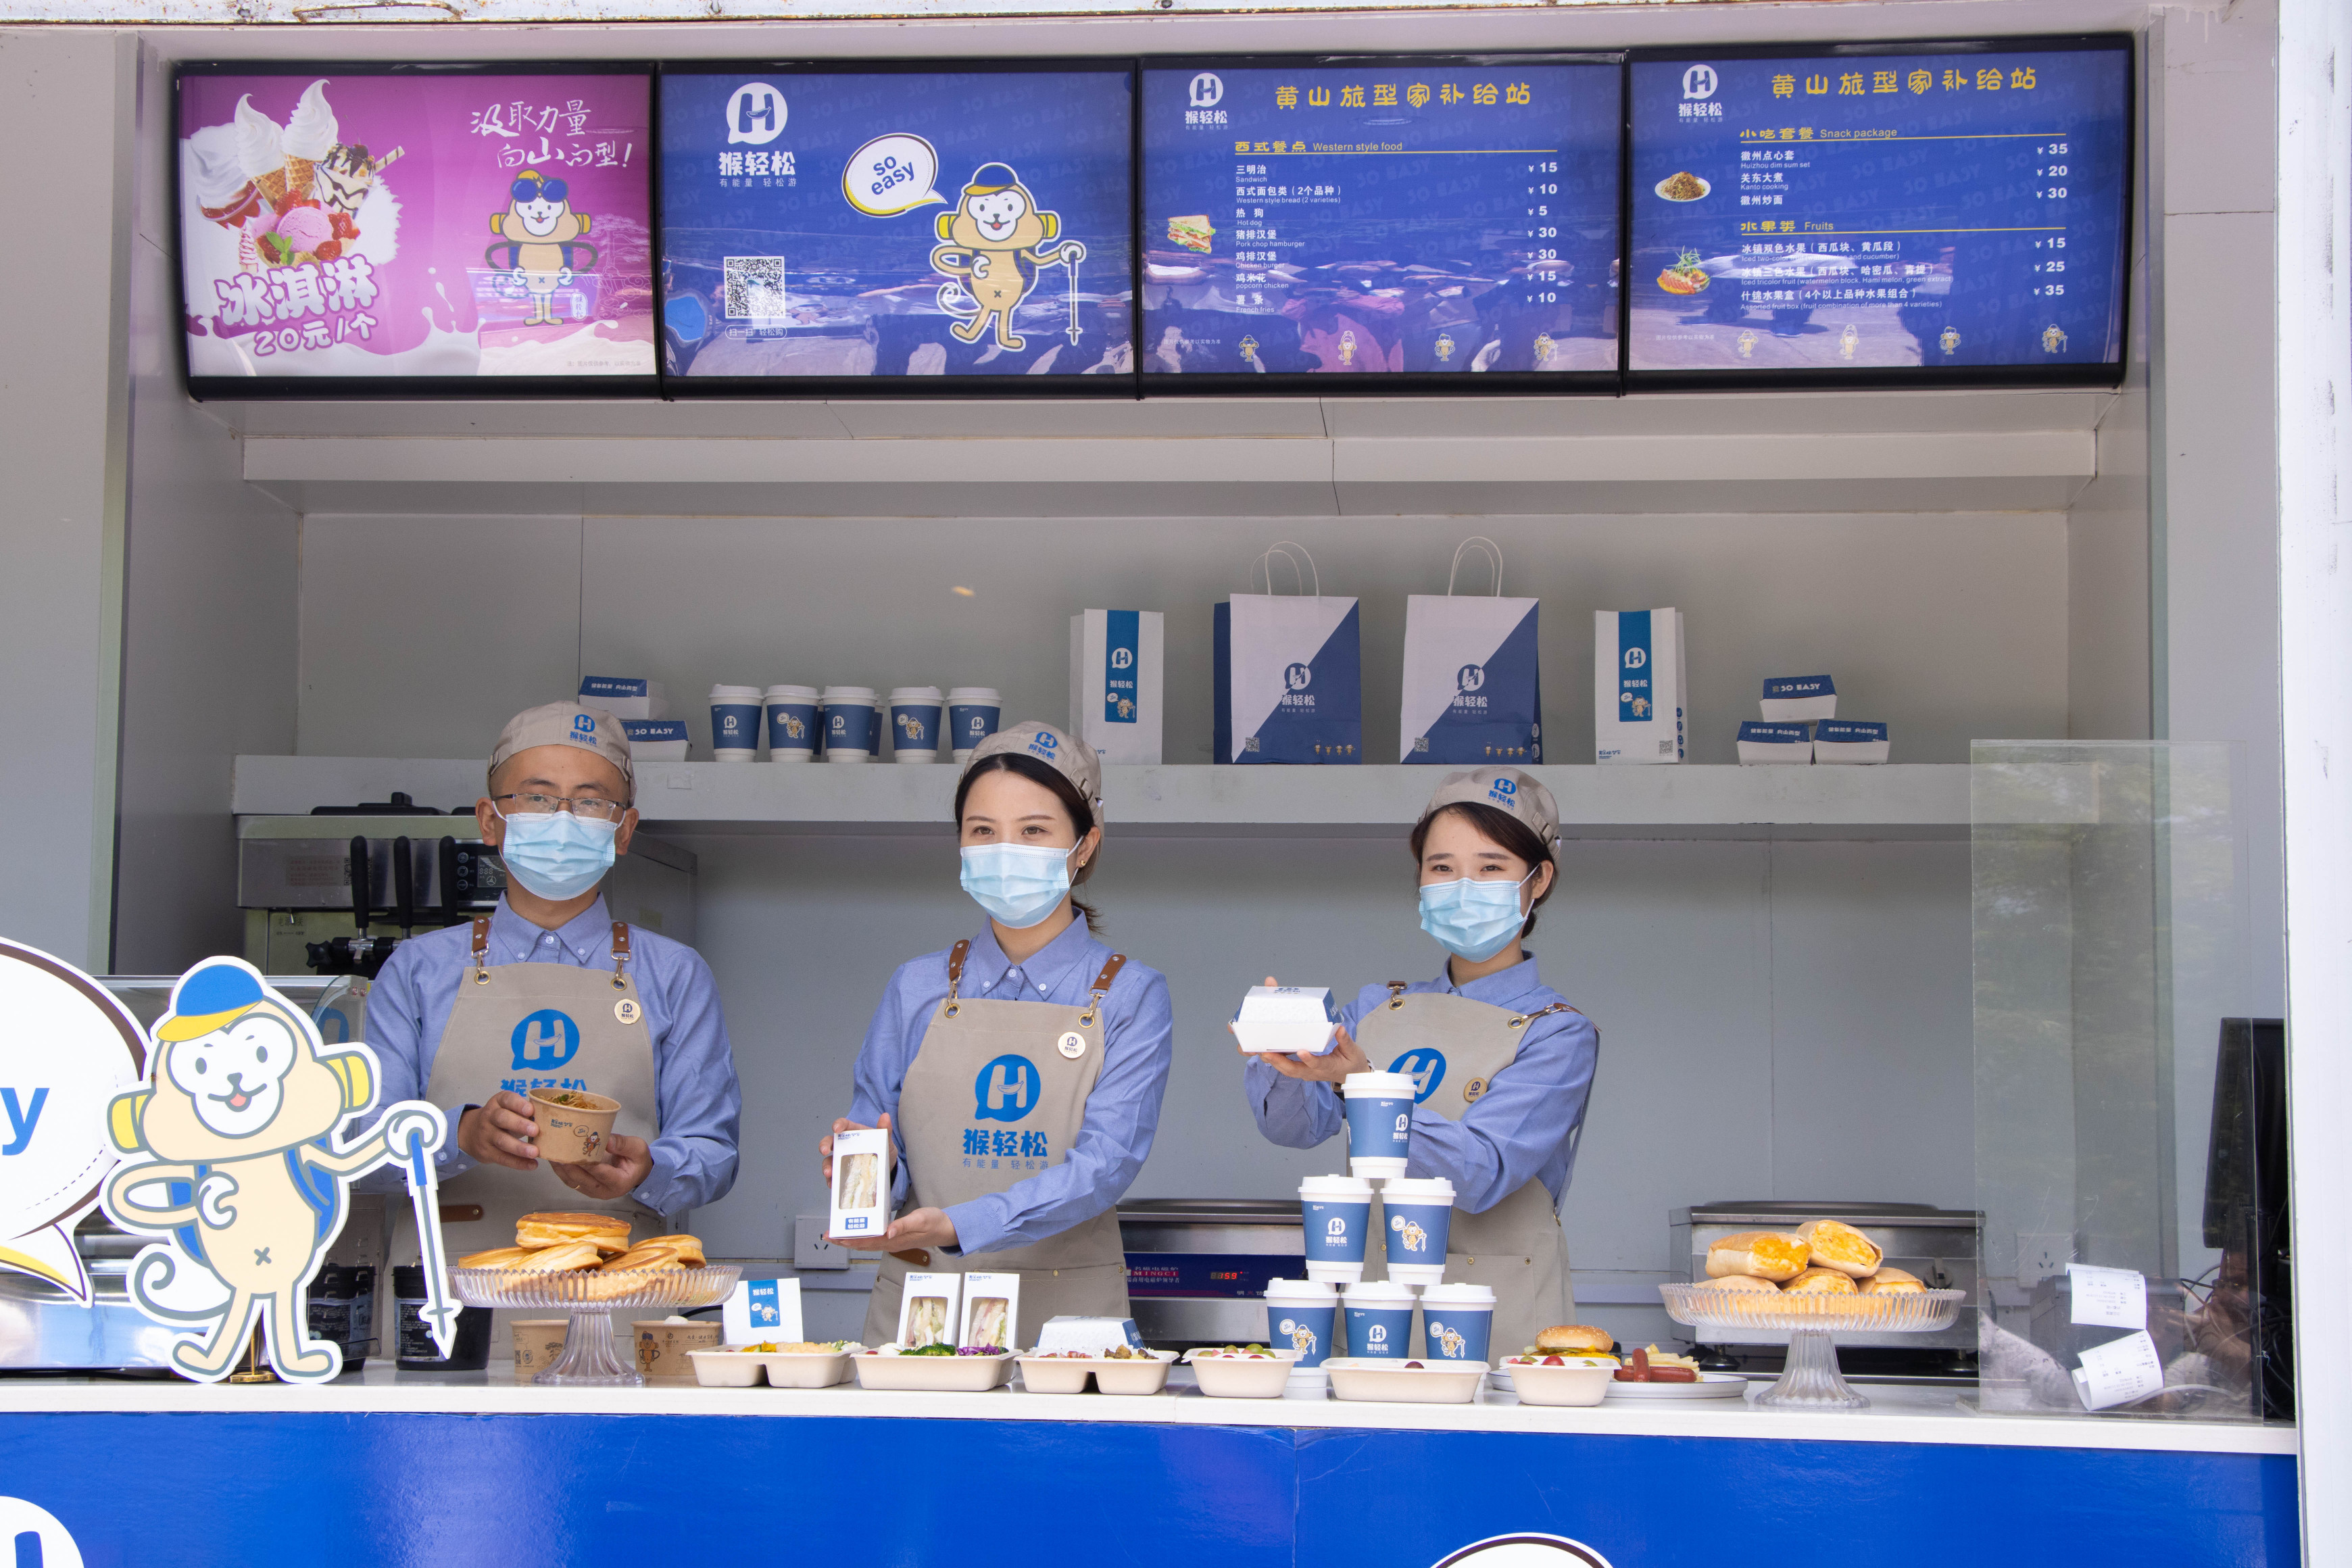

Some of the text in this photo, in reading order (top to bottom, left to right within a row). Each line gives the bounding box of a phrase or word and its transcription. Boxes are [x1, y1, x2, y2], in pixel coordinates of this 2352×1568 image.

[1771, 67, 2036, 99] 黄山旅型家补给站
[1275, 82, 1531, 109] 黄山旅型家补给站
[1678, 102, 1723, 117] 猴轻松
[470, 99, 591, 137] 汲取力量
[1185, 110, 1227, 124] 猴轻松
[1740, 127, 1897, 140] 小吃套餐 Snack package
[1235, 141, 1402, 153] 西式餐点 Western style food
[1741, 150, 1794, 161] 徽州点心套
[718, 151, 796, 176] 猴轻松
[873, 156, 897, 176] so
[1235, 165, 1267, 174] 三明治
[871, 161, 914, 195] easy
[1741, 172, 1784, 183] 关东大煮
[1265, 197, 1281, 205] style
[1740, 195, 1783, 205] 徽州炒面
[1805, 222, 1834, 230] Fruits
[1235, 230, 1277, 239] 猪排汉堡
[1235, 251, 1277, 261] 鸡排汉堡
[1235, 273, 1266, 283] 鸡米花
[214, 254, 379, 326] 冰淇淋
[729, 328, 754, 337] 扫一扫
[1110, 680, 1133, 689] 猴轻松
[1623, 679, 1648, 687] 猴轻松
[1281, 694, 1315, 706] 猴轻松
[1453, 695, 1488, 708] 猴轻松
[570, 731, 597, 745] 猴轻松
[1028, 743, 1056, 760] 猴轻松
[1488, 789, 1515, 808] 猴轻松
[962, 1129, 1048, 1158] 猴轻松
[962, 1158, 1049, 1170] 有能量 轻松游
[752, 1288, 774, 1296] 猴轻松
